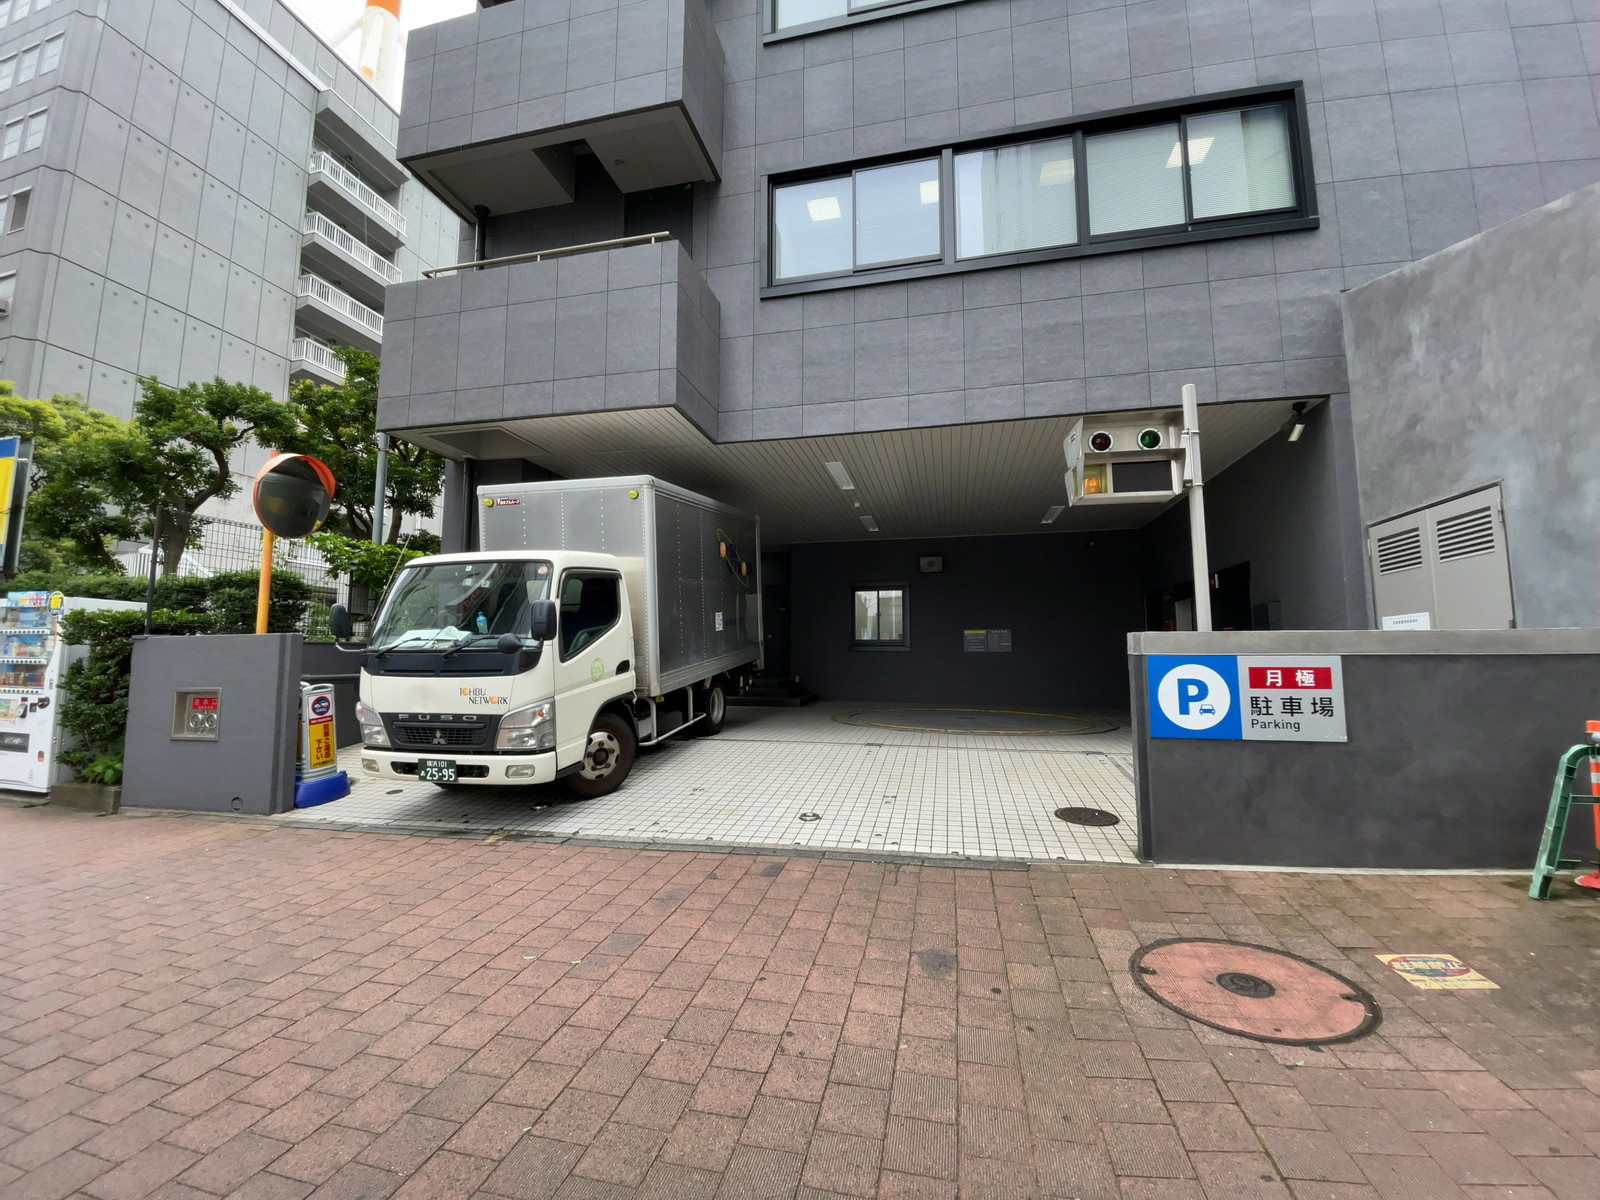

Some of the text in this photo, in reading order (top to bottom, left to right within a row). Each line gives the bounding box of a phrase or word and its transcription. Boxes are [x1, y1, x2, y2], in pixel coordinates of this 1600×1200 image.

[1265, 669, 1316, 687] 月極
[459, 687, 486, 696] TOHBU
[1177, 678, 1209, 716] P
[468, 696, 508, 705] NETWORK
[1250, 696, 1335, 718] 駐車場
[398, 713, 477, 721] FUSO
[1251, 719, 1301, 732] Parking
[426, 767, 455, 781] 25-95
